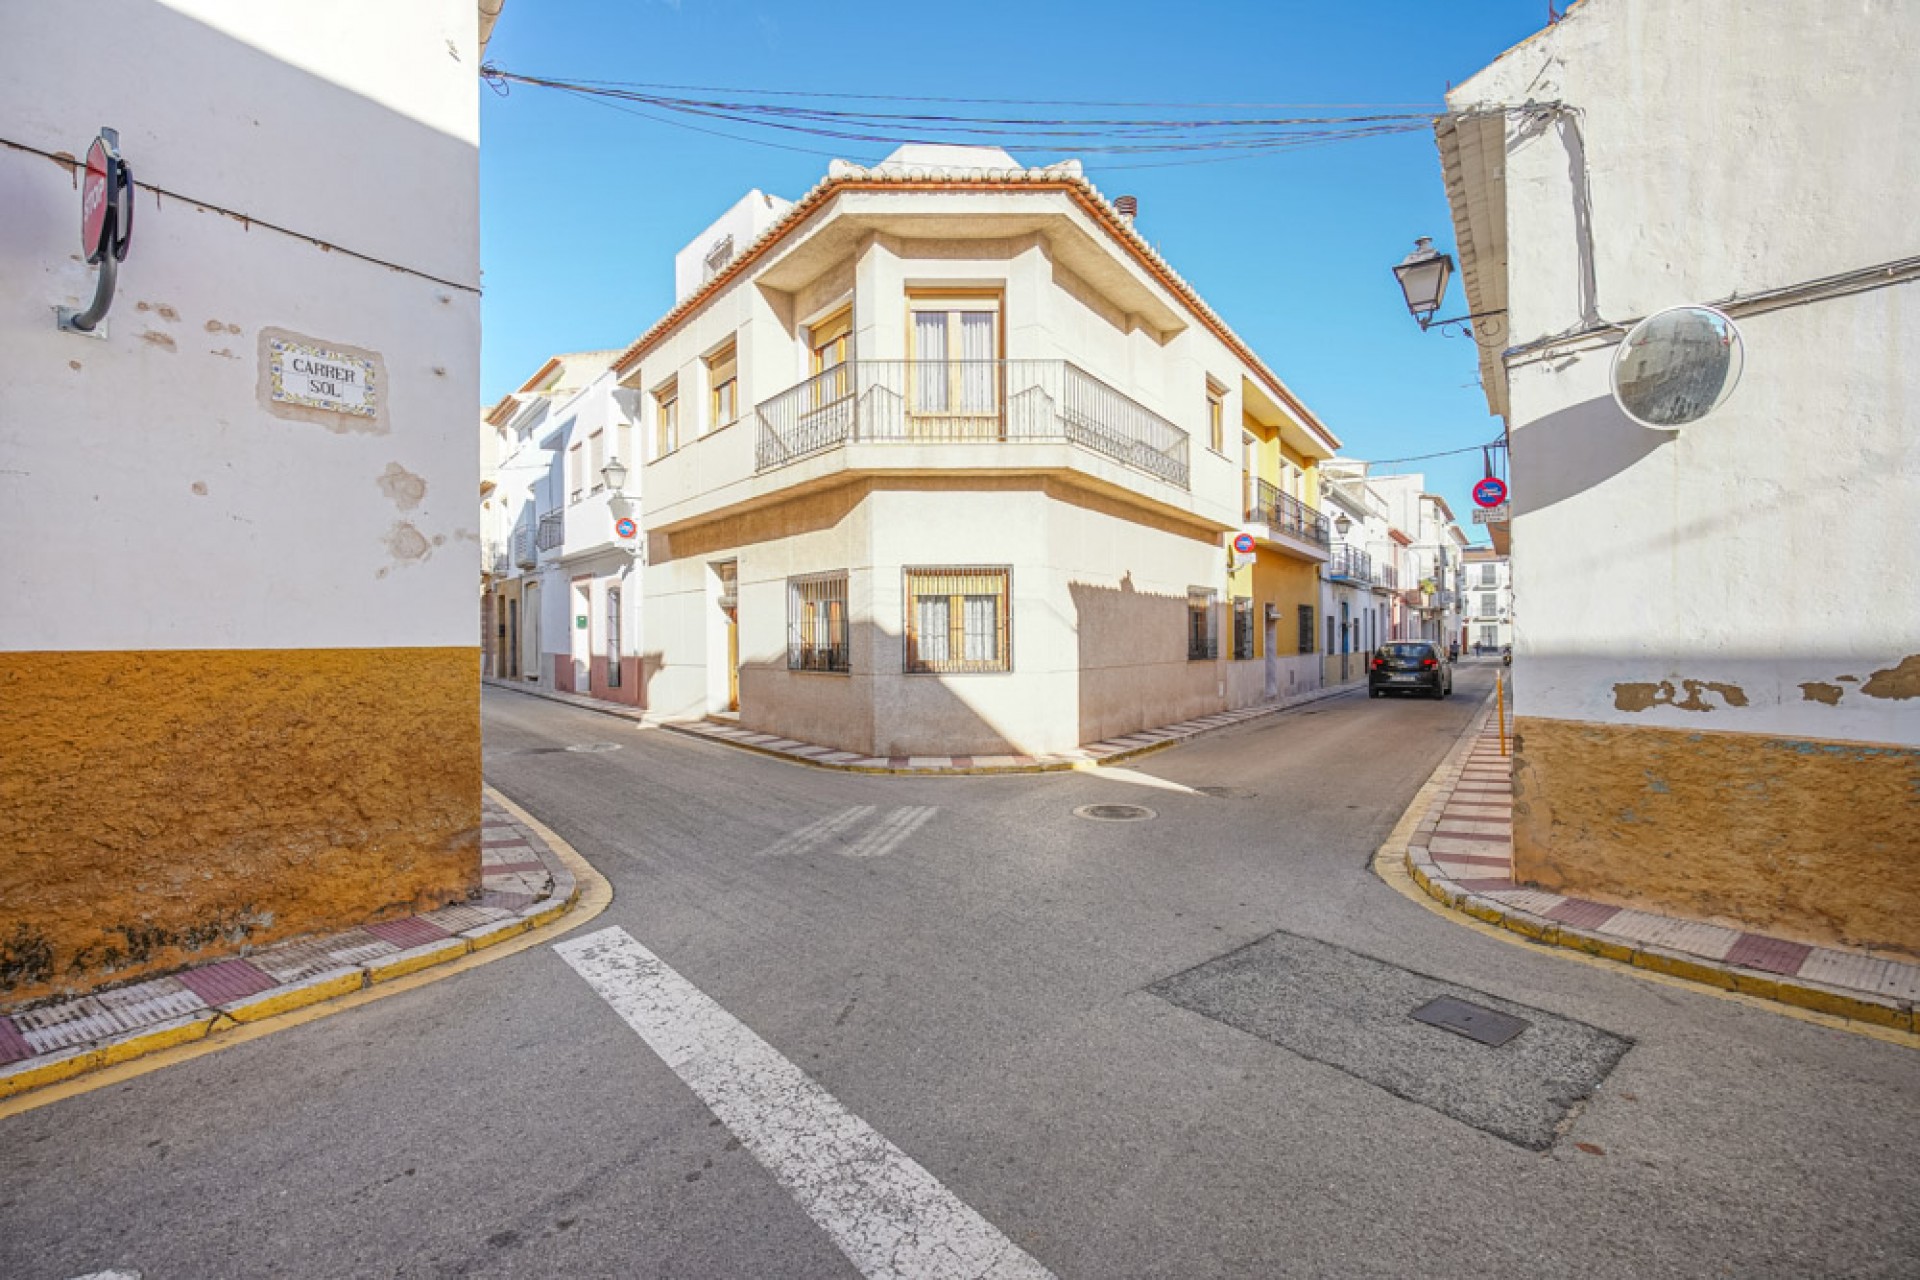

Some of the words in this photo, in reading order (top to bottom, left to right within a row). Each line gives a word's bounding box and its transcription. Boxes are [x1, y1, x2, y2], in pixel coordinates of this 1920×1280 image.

[84, 178, 104, 218] STOP
[293, 358, 355, 383] CARRER
[310, 379, 341, 398] SOL
